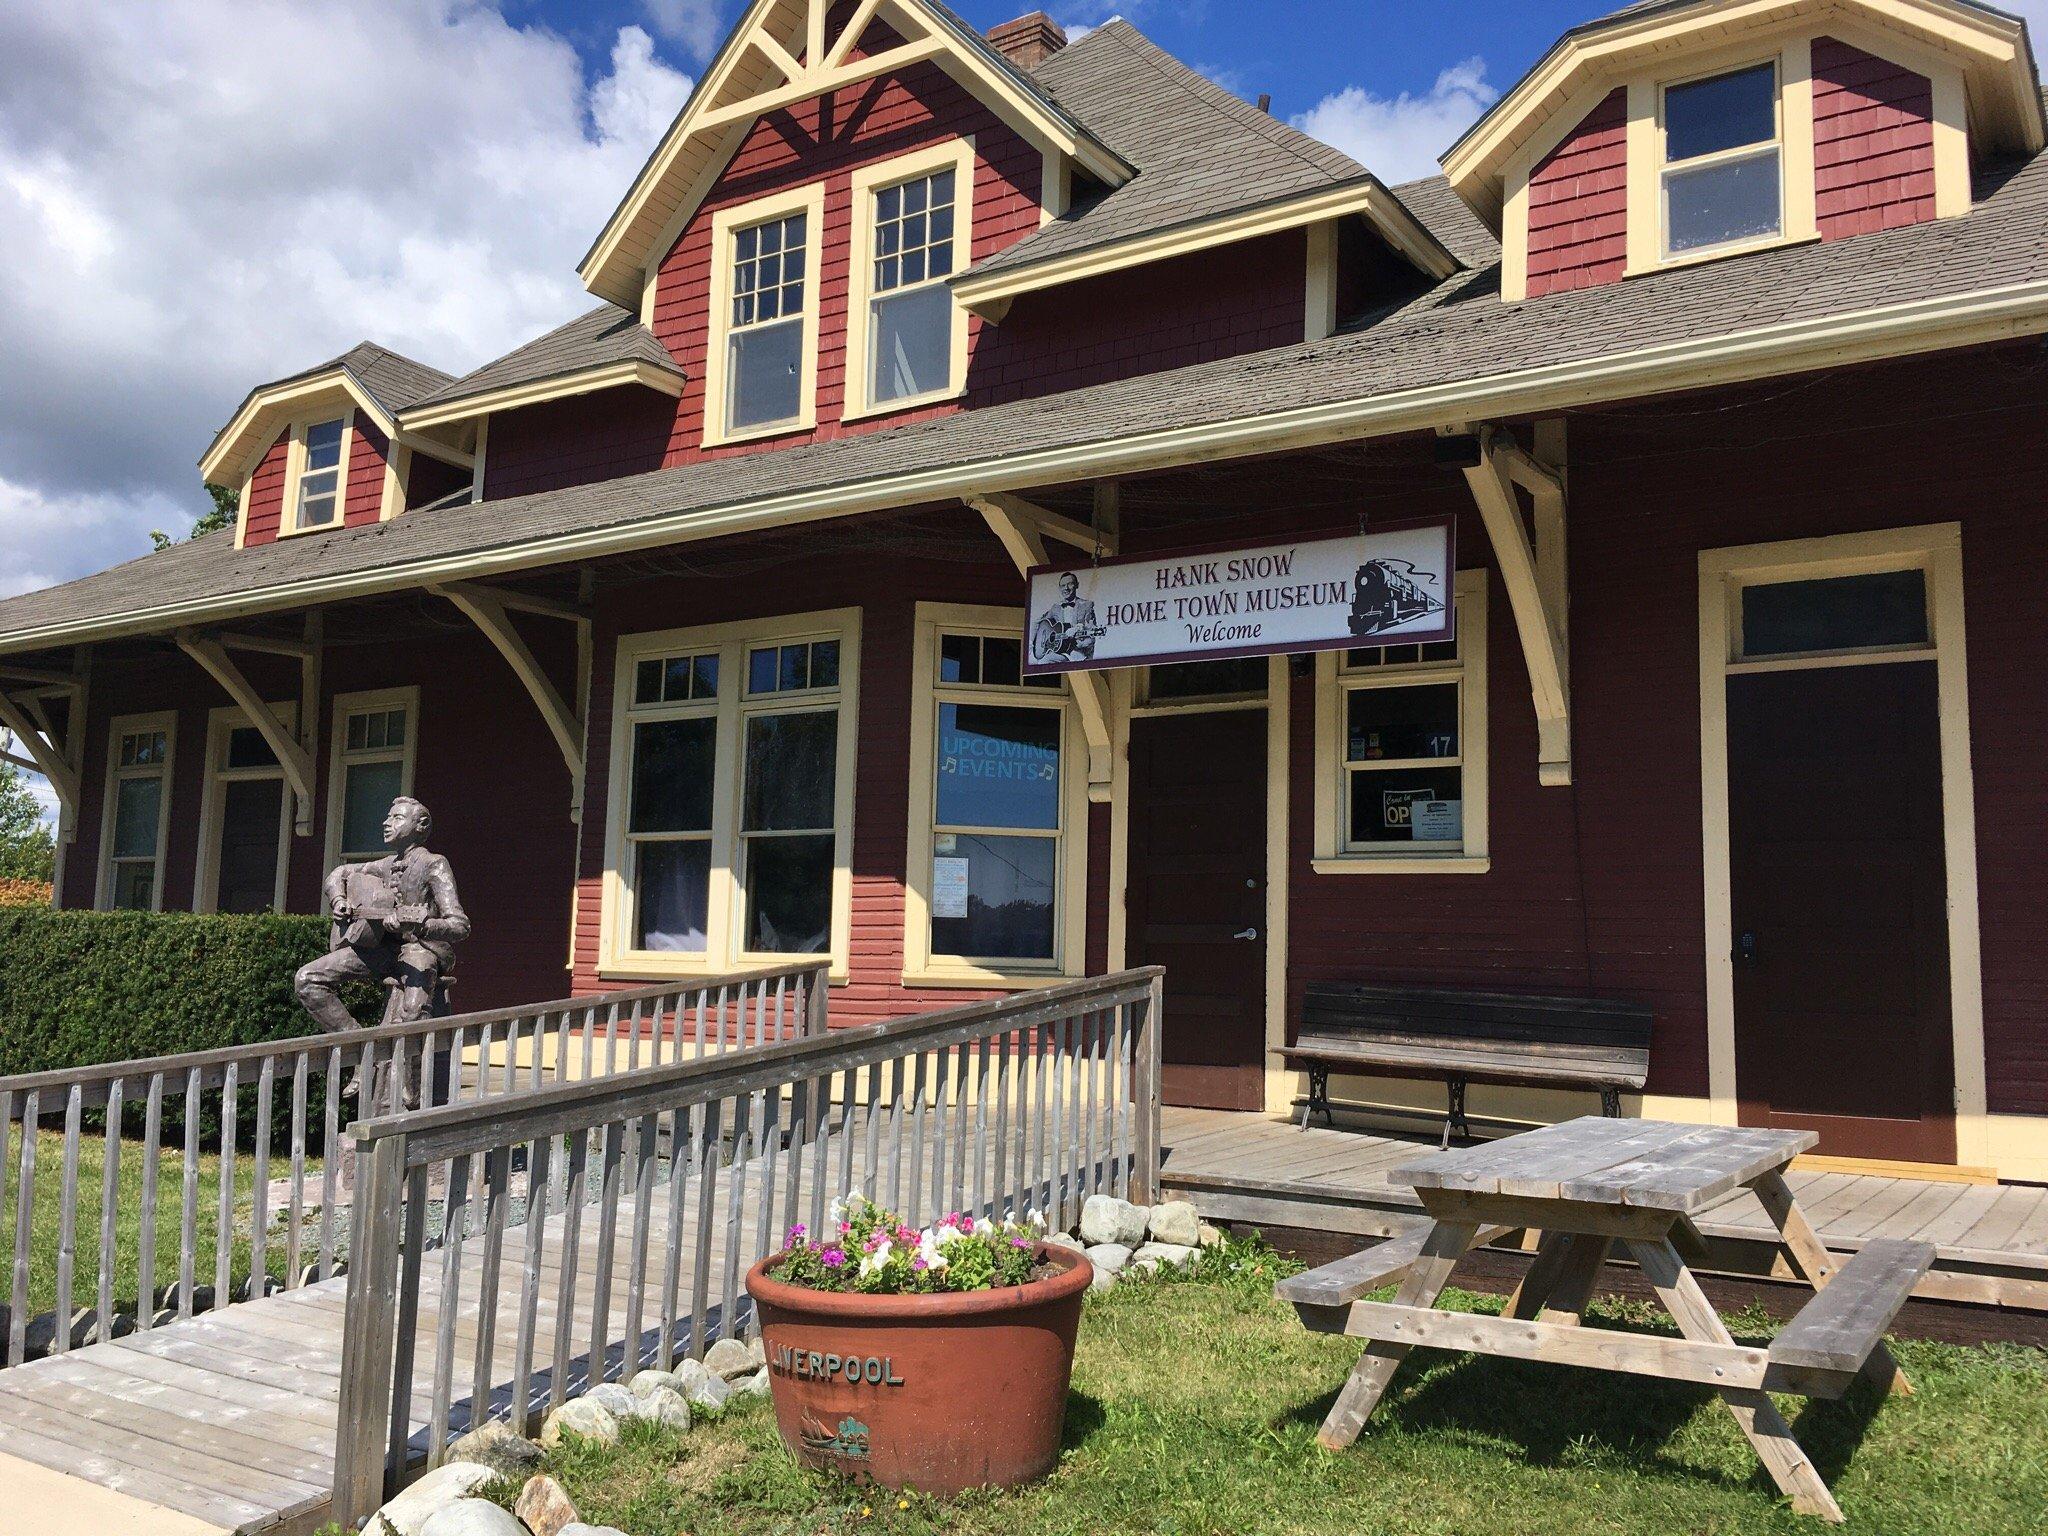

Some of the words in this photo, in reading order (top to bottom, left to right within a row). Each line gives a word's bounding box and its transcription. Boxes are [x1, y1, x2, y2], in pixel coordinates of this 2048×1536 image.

[1155, 562, 1220, 590] HANK
[1227, 549, 1297, 581] SNOW
[1106, 599, 1167, 626] HOME
[1174, 588, 1238, 620] TOWN
[1245, 580, 1348, 612] MUSEUM
[1185, 620, 1262, 644] Welcome
[943, 737, 1058, 760] UPCOMING
[1430, 736, 1451, 757] 17
[959, 759, 1038, 780] EVENTS
[1387, 806, 1412, 824] OP
[768, 1340, 904, 1385] LIVERPOOL
